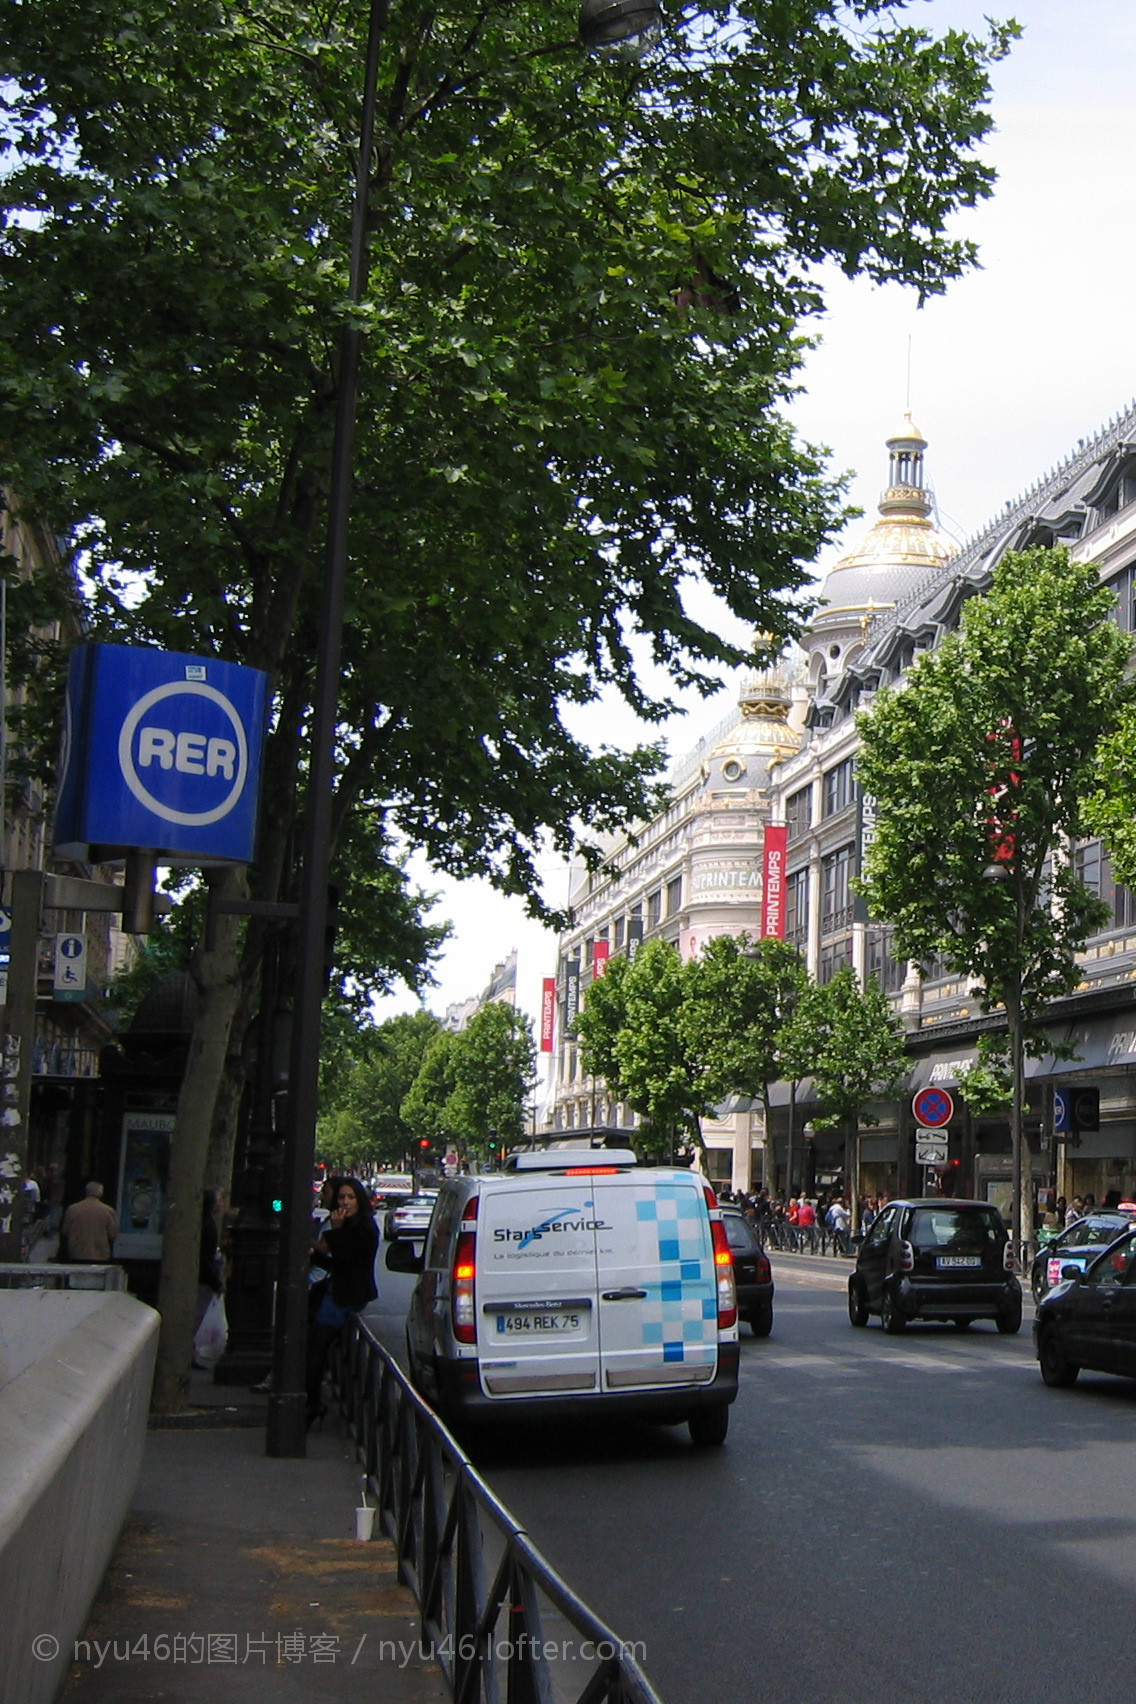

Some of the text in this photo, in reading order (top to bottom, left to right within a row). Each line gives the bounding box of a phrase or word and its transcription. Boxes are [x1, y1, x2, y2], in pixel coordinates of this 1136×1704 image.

[139, 727, 236, 780] RER
[701, 871, 764, 889] PRINTEM
[766, 850, 781, 936] PRINTEMPS
[506, 1315, 579, 1330] 494 REK 75
